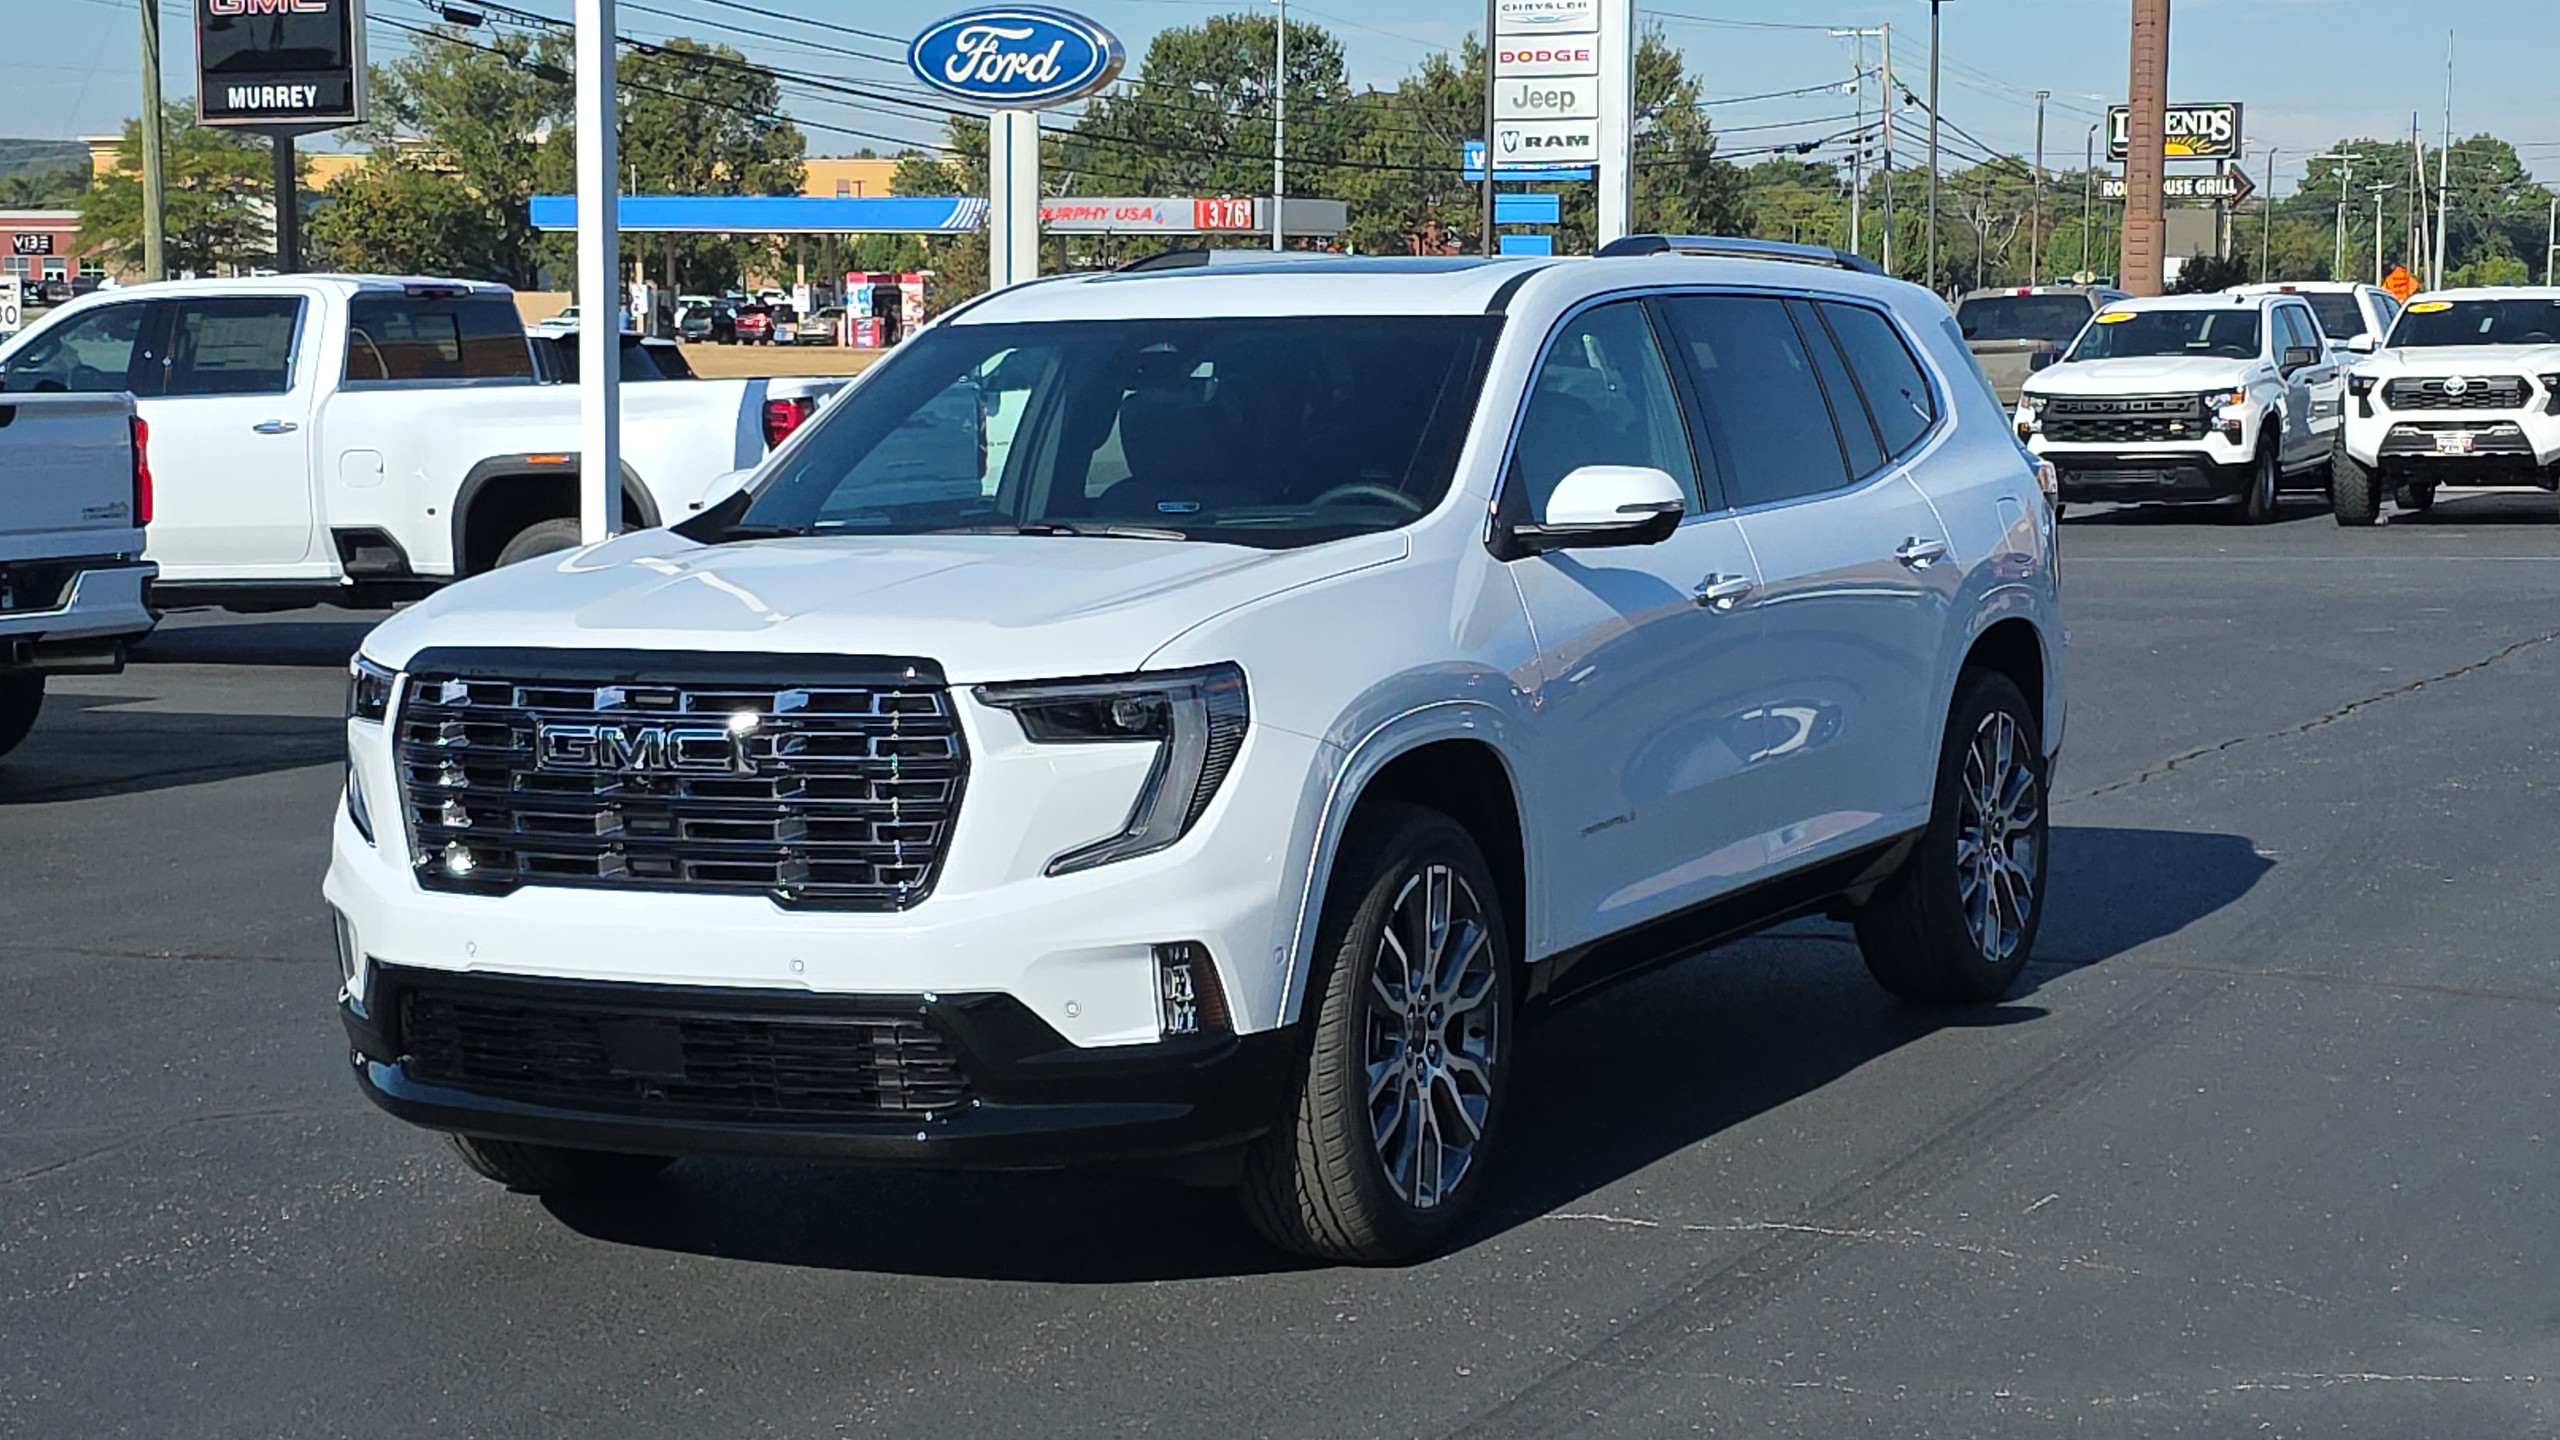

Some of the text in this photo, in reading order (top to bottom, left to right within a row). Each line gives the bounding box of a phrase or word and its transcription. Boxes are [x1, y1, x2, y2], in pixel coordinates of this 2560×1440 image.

[1501, 2, 1587, 11] CHRYSLER
[945, 25, 1065, 84] Ford
[1500, 49, 1590, 63] DODGE
[228, 85, 317, 109] MURREY
[1512, 84, 1576, 113] Jeep
[2113, 110, 2231, 142] LENDS
[1525, 135, 1590, 148] RAM
[2195, 177, 2237, 195] GRILL
[1115, 206, 1153, 221] USA
[540, 725, 733, 772] GMC
